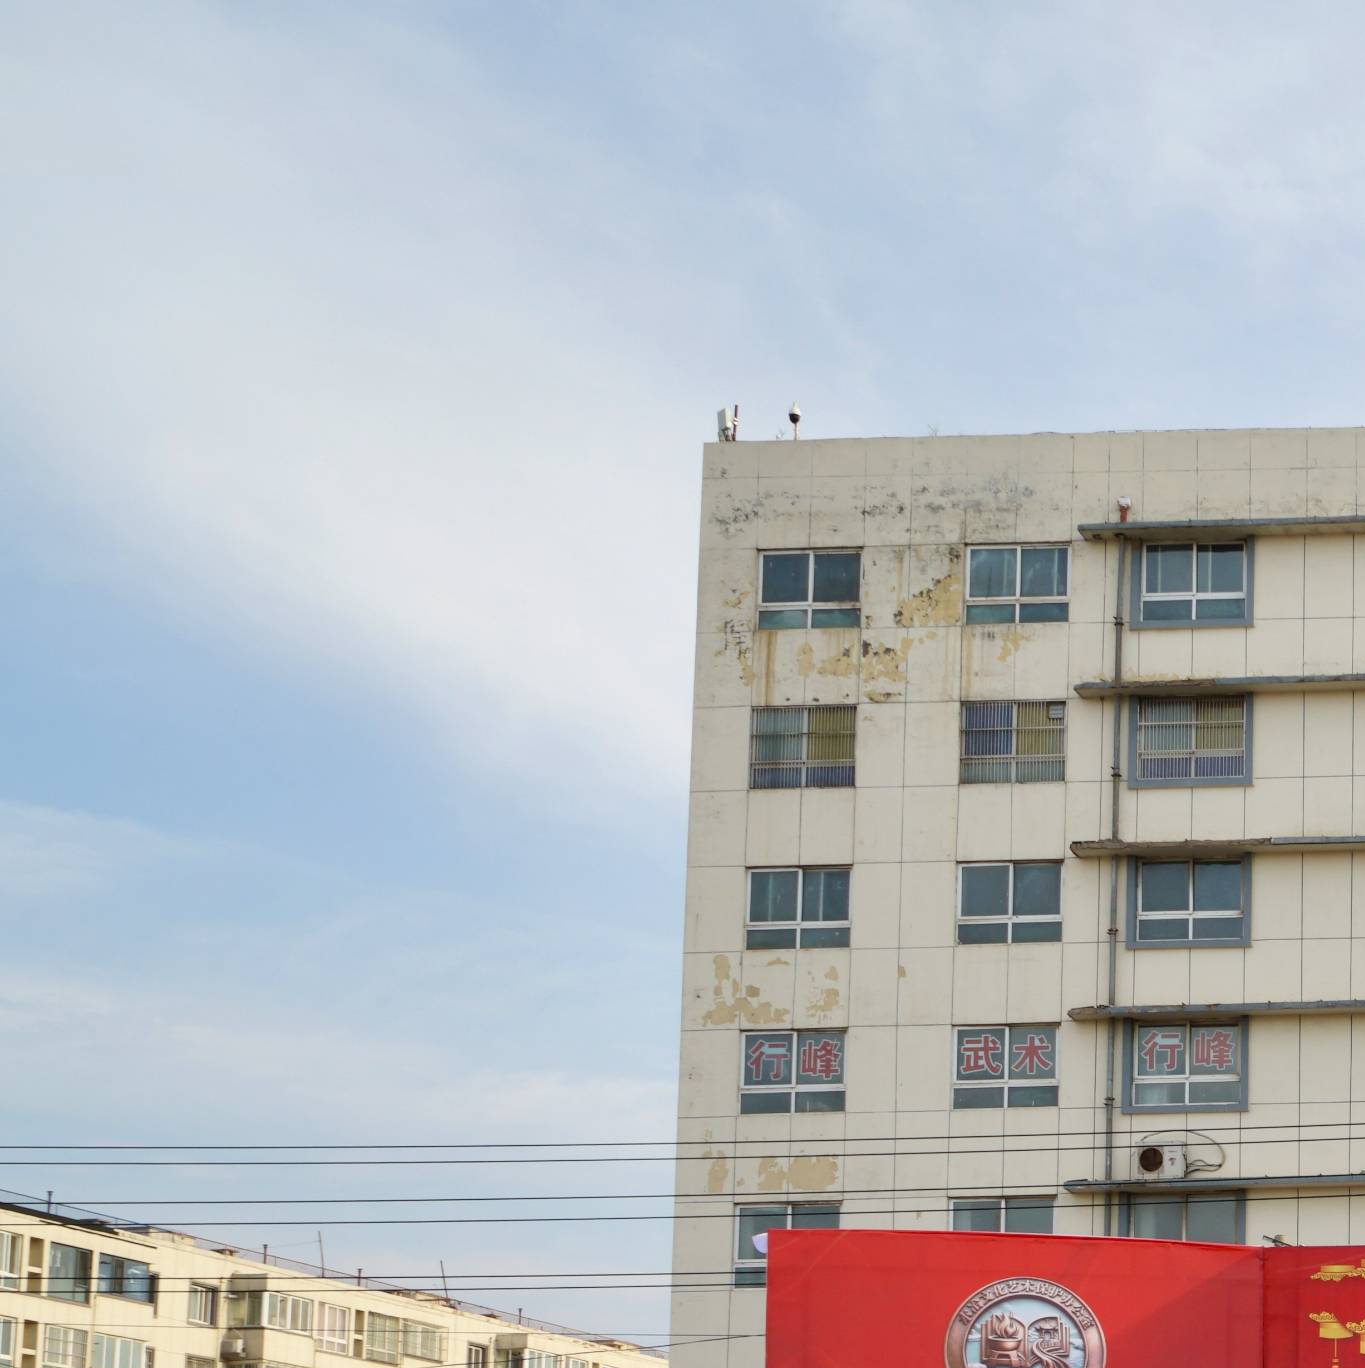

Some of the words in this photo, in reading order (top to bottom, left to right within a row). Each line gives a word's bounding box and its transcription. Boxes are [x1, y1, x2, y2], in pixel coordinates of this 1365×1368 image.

[747, 1039, 841, 1081] 行峰
[960, 1034, 1054, 1076] 武术
[1141, 1030, 1236, 1072] 行峰
